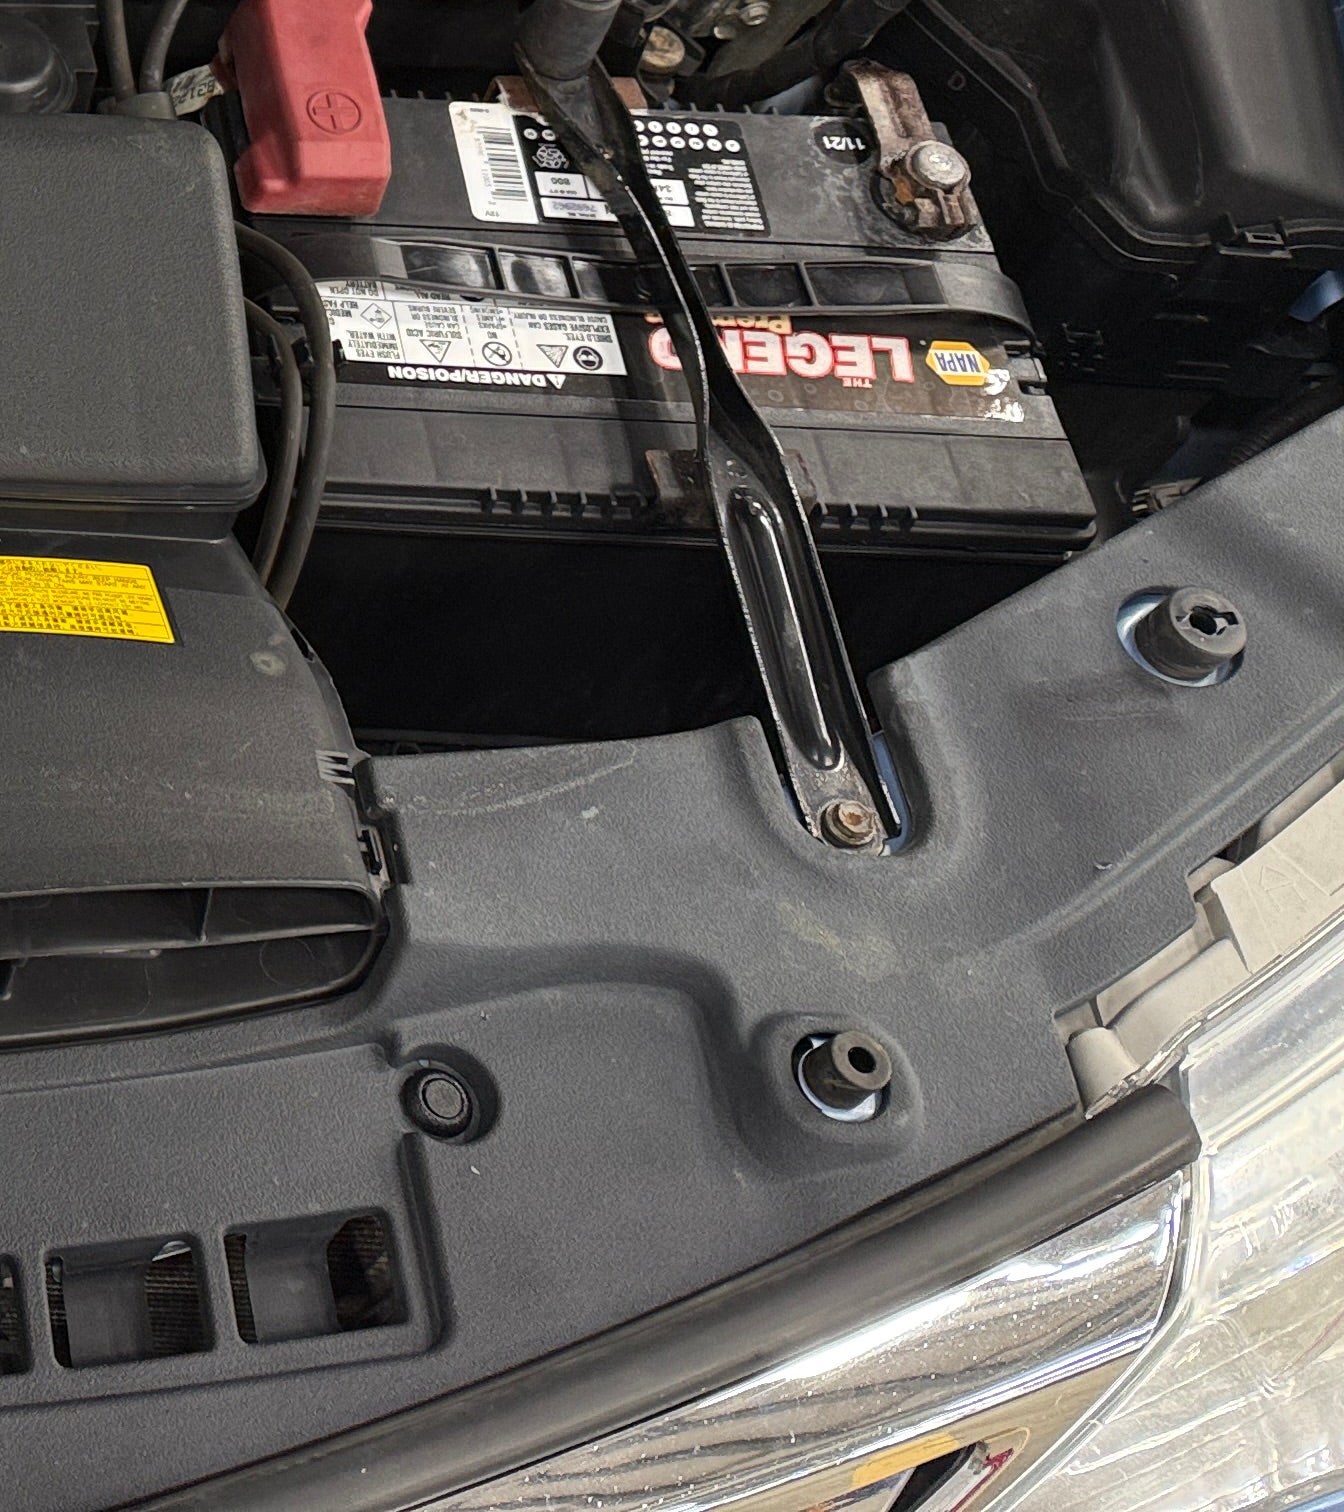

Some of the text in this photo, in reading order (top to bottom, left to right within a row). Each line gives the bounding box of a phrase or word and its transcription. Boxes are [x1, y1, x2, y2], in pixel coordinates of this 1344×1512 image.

[822, 136, 866, 151] 11/21
[934, 351, 980, 374] NAPA
[387, 365, 547, 387] DANGER/POISON
[842, 377, 873, 389] THE
